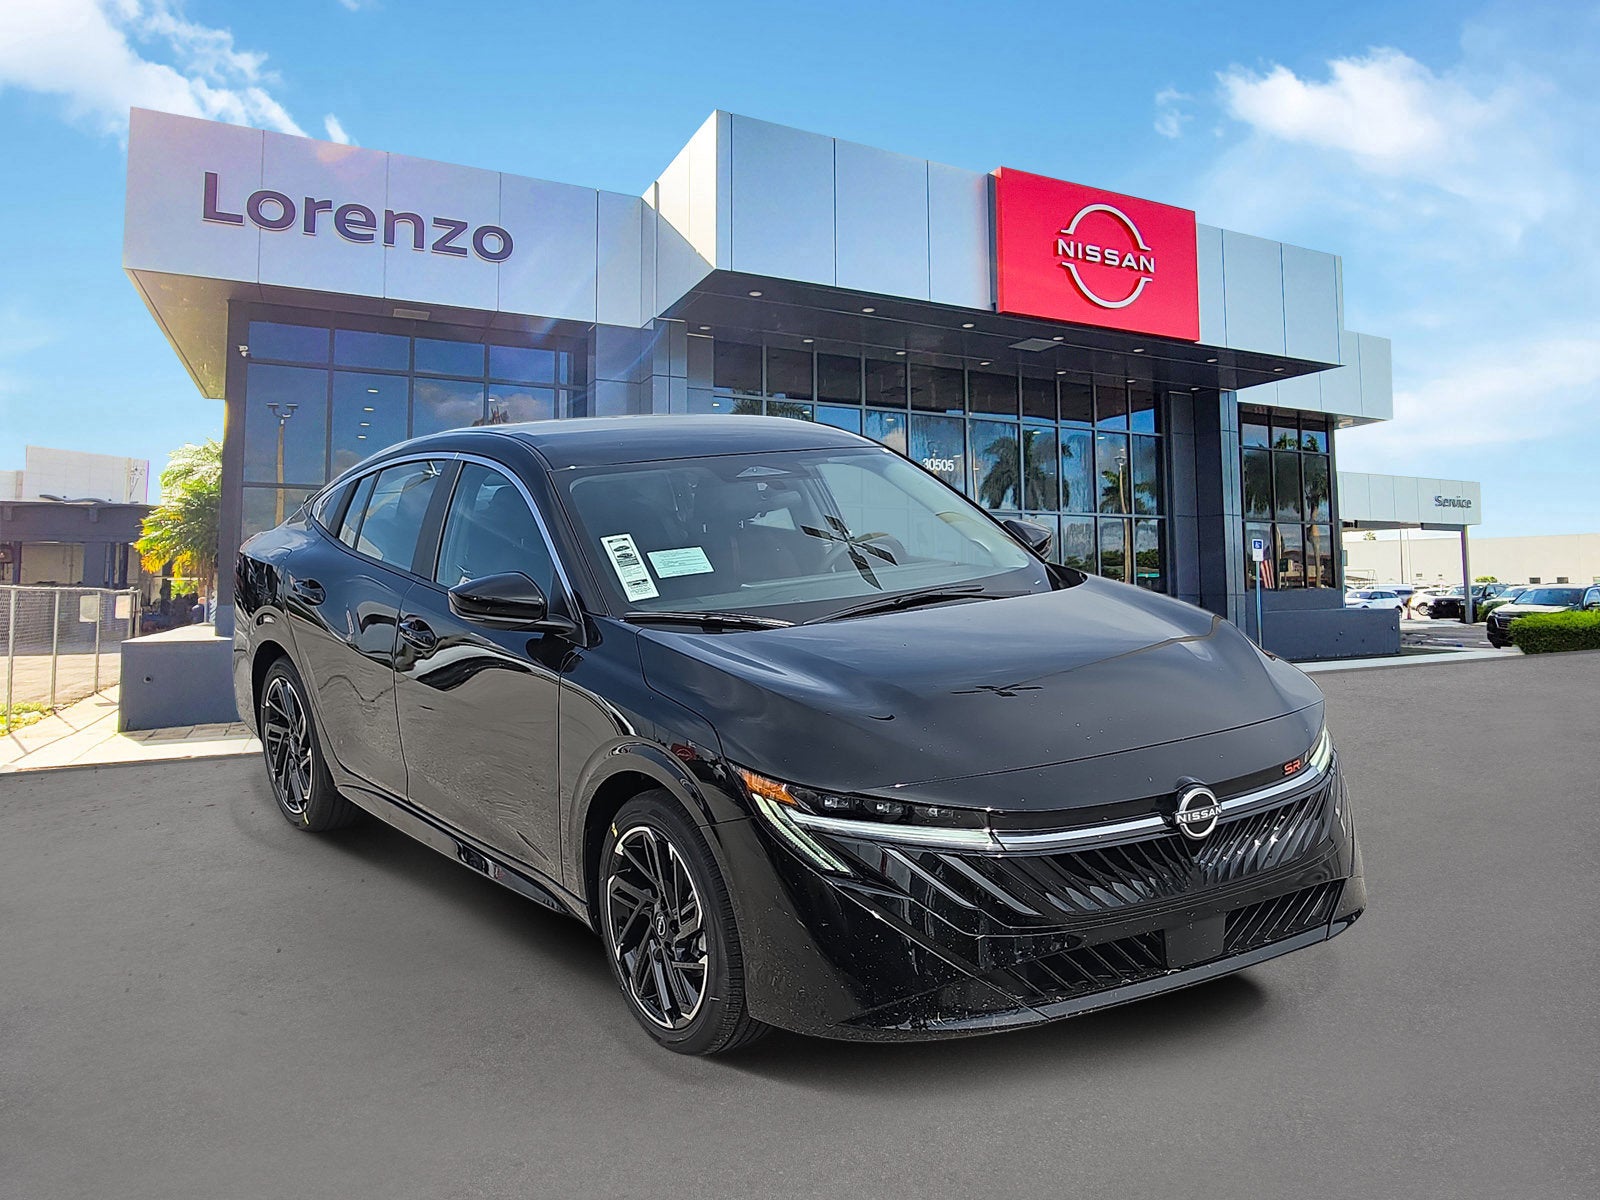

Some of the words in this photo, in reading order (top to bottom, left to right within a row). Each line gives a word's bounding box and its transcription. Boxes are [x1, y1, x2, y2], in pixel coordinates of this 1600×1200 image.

[202, 171, 514, 262] Lorenzo
[1057, 238, 1155, 273] NISSAN
[922, 457, 955, 472] 30505
[1434, 495, 1472, 508] Service
[1284, 759, 1301, 775] SR
[1176, 805, 1222, 823] NISSAN
